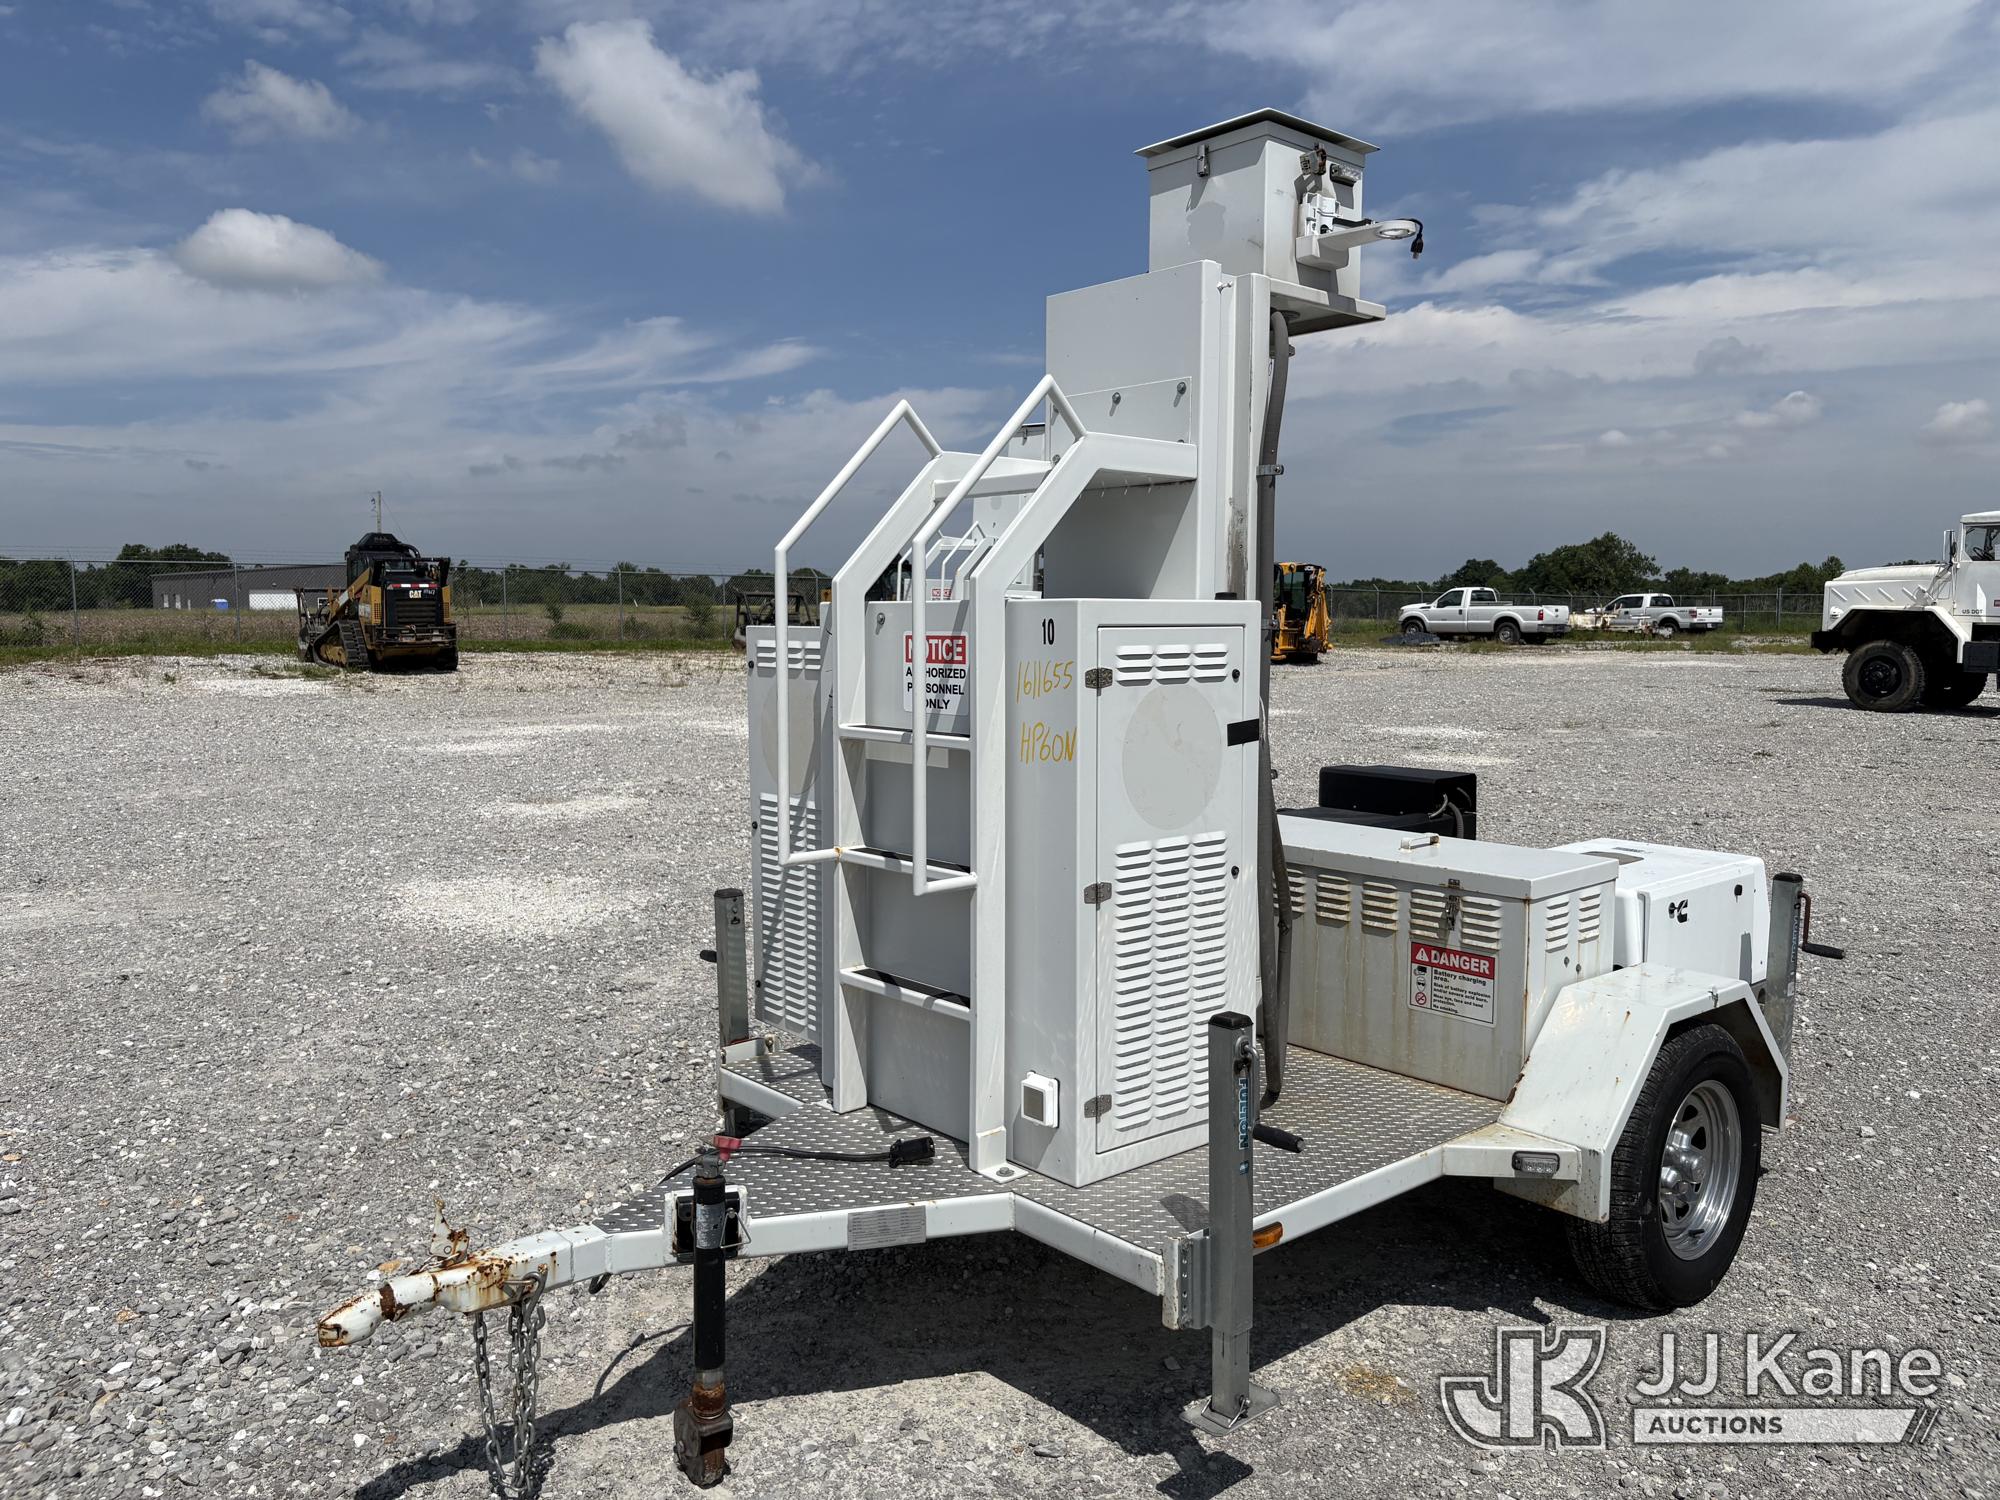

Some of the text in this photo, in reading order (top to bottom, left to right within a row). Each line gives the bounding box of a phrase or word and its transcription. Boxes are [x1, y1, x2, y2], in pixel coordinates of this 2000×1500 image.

[409, 590, 422, 598] CAT
[1042, 618, 1055, 645] 10
[908, 638, 963, 660] TICE
[905, 666, 966, 679] AHORIZED
[907, 682, 964, 695] PSONNEL
[1016, 660, 1075, 704] 1611655
[926, 698, 950, 710] NLY
[1431, 949, 1490, 974] DANGER
[1433, 969, 1486, 986] Battery charging
[1433, 975, 1450, 983] area.
[1239, 1078, 1249, 1150] FULTON
